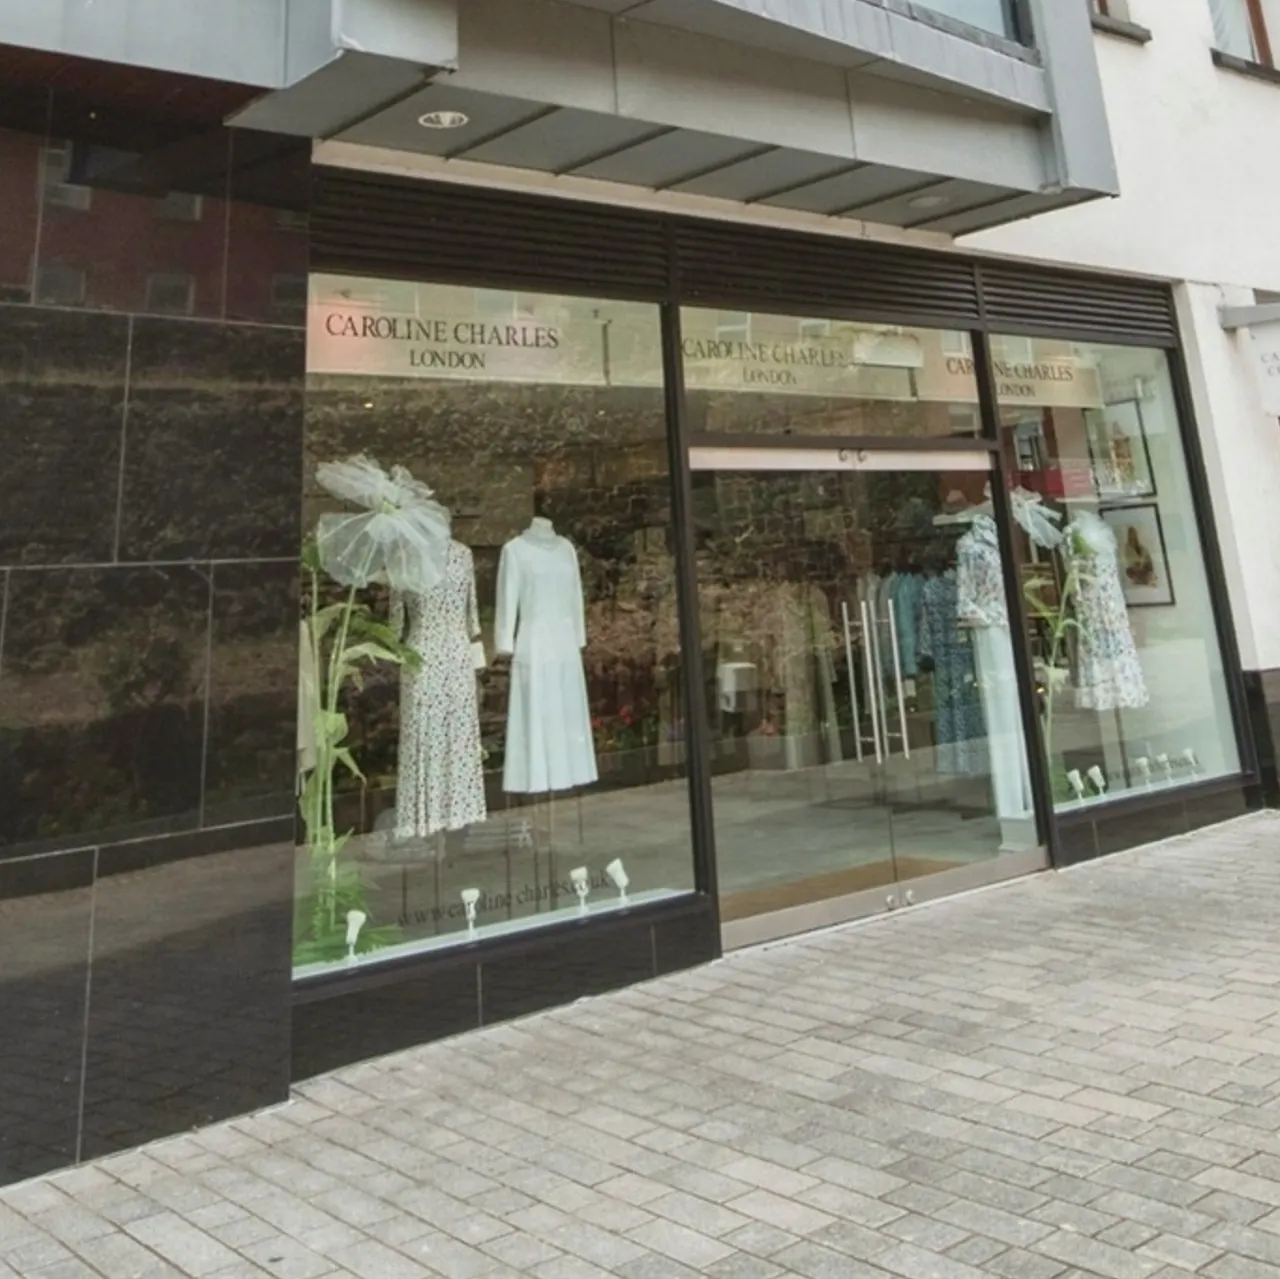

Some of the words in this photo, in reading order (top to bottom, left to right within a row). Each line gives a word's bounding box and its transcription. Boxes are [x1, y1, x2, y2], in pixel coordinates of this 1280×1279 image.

[325, 313, 448, 342] CAROLINE
[453, 322, 560, 349] CHARLES
[409, 348, 487, 370] LONDON
[681, 337, 769, 363] CAROLINE
[742, 366, 797, 386] LONDON
[1014, 362, 1074, 382] CHARLES
